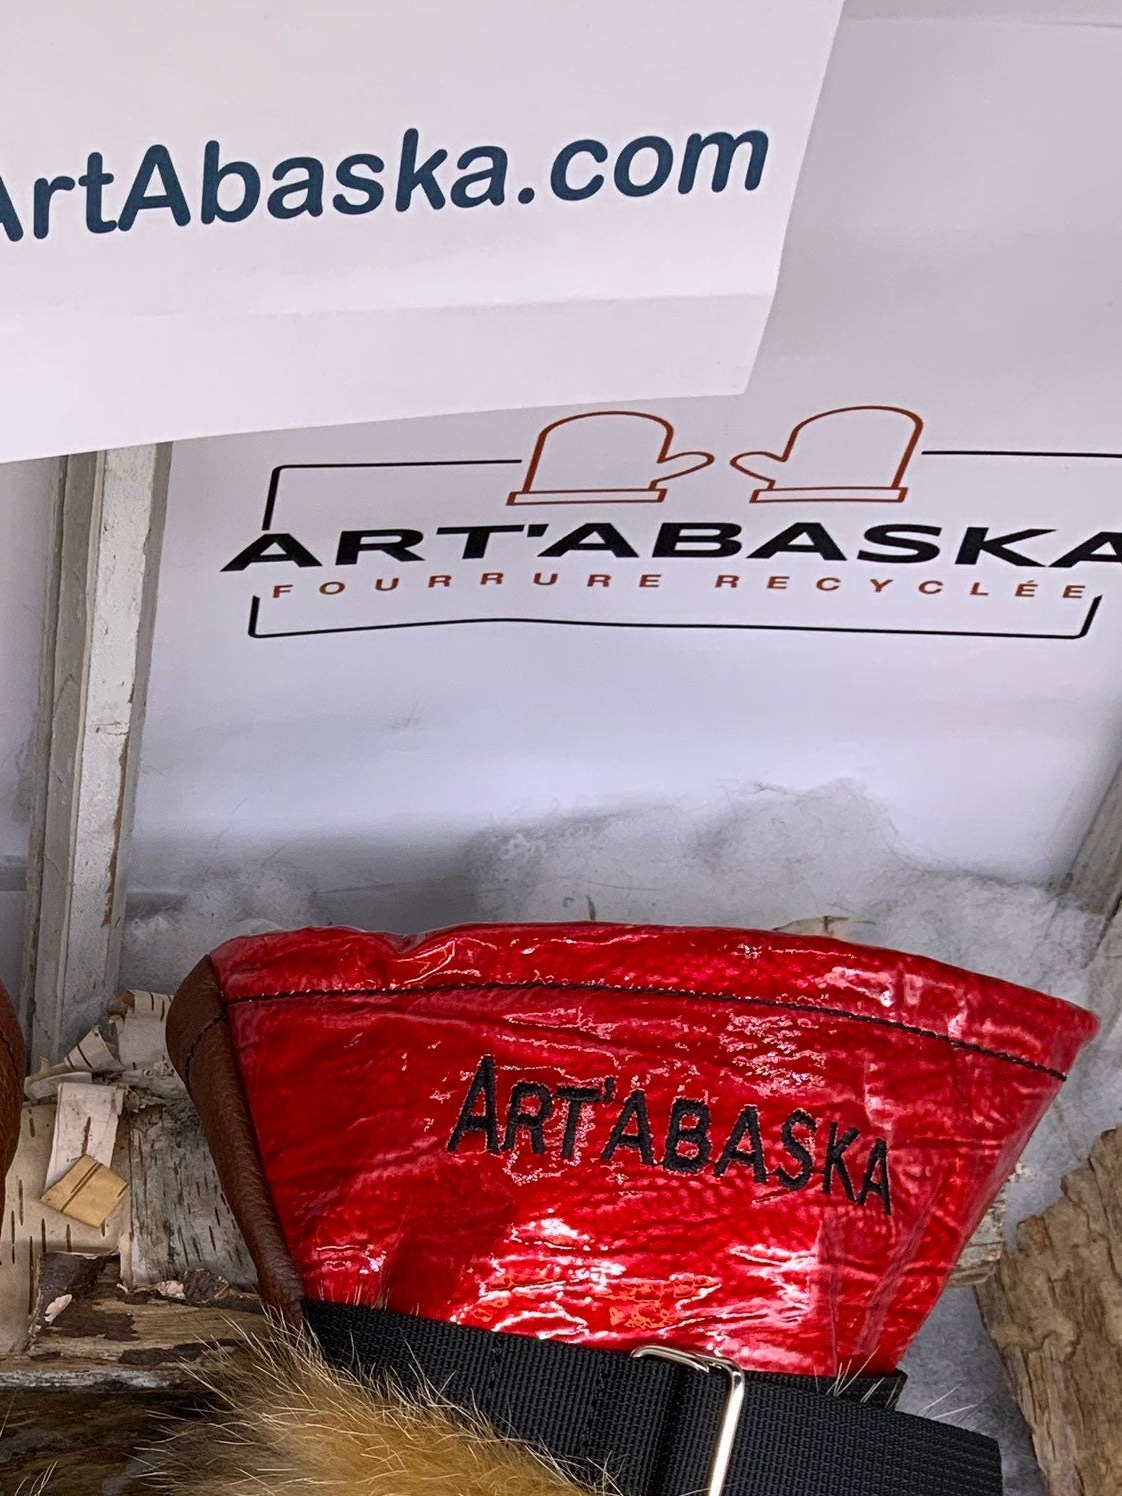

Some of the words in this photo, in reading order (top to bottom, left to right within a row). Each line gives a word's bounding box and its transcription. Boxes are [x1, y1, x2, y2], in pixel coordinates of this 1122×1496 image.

[219, 521, 1122, 572] ART'ABASKA
[272, 572, 661, 600] FOURRURE
[715, 573, 1085, 599] RECYCLÉE
